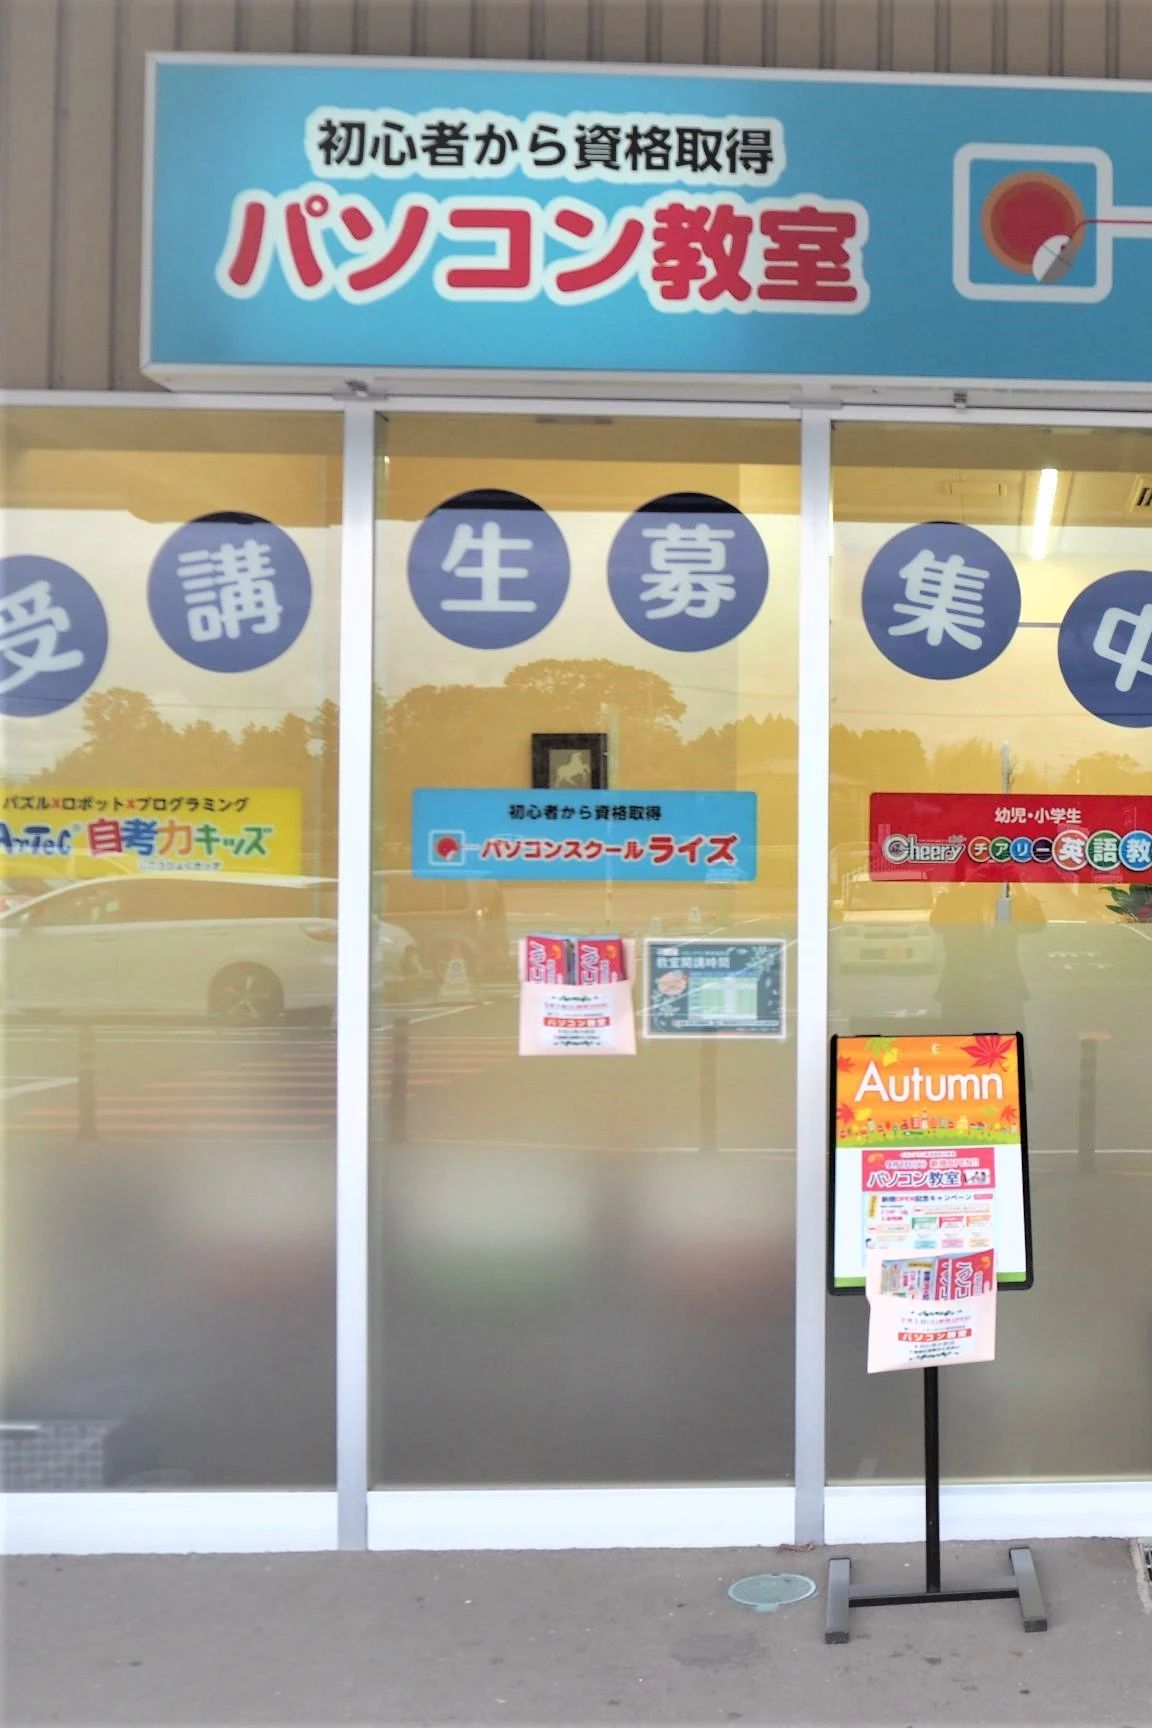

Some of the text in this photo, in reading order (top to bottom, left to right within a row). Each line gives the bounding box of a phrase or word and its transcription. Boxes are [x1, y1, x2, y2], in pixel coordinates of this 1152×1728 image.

[317, 119, 775, 174] 初心者から資格取得
[228, 194, 859, 304] パソコン教室
[508, 804, 663, 821] 初心者から資格取得
[994, 806, 1082, 825] 幼児・小学生
[87, 817, 273, 857] 自考力キッズ
[481, 834, 739, 865] パソコンスクールライズ
[883, 833, 967, 864] Cheery
[854, 1060, 1004, 1103] Autumn
[868, 1170, 960, 1187] パソコン教室
